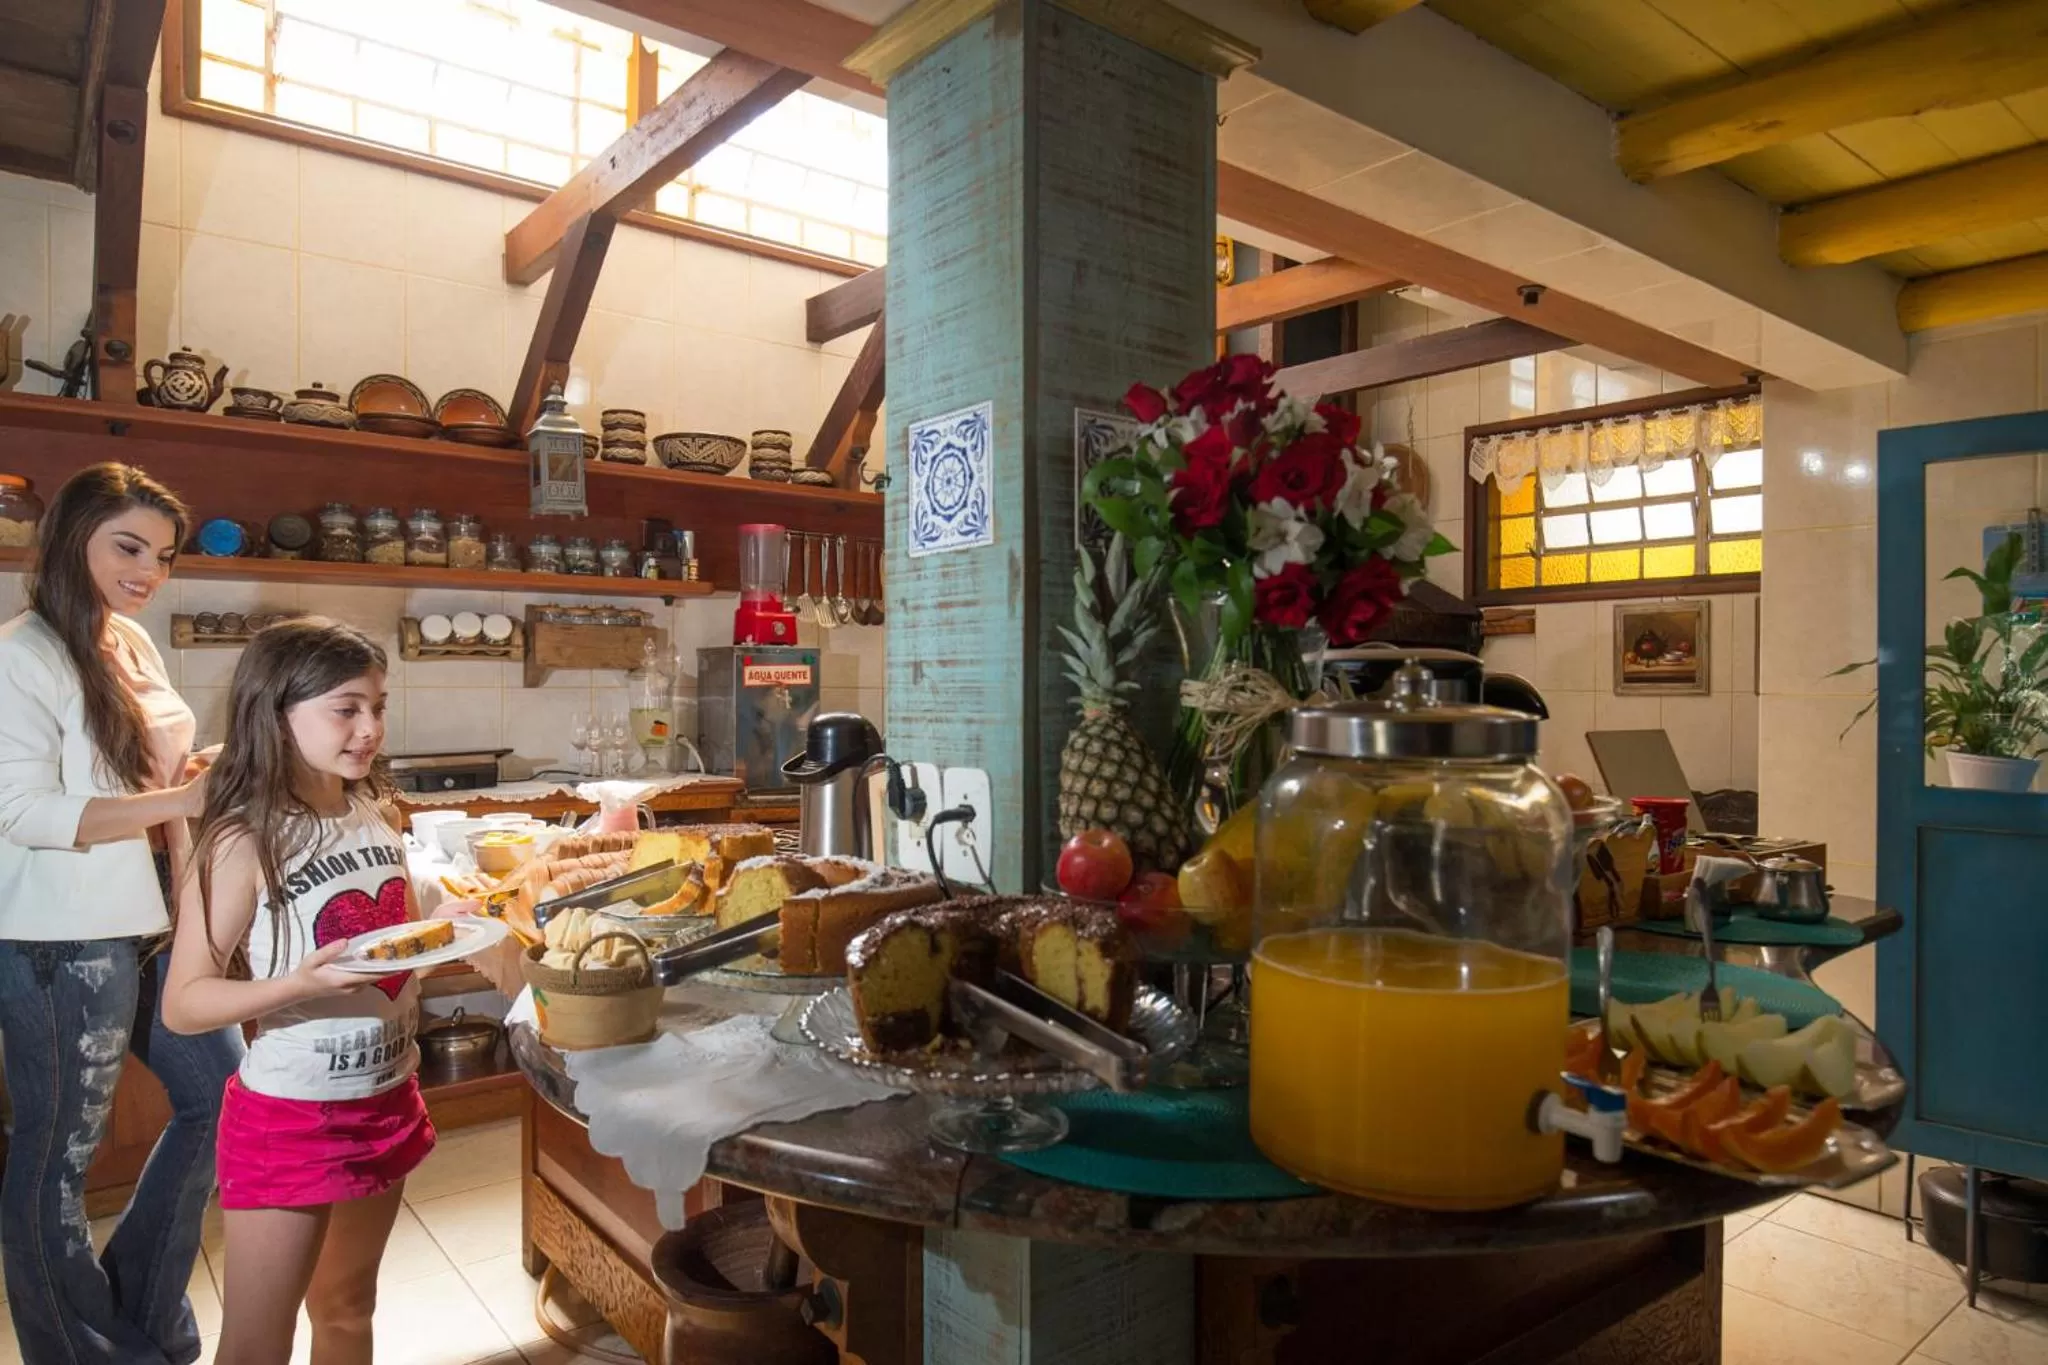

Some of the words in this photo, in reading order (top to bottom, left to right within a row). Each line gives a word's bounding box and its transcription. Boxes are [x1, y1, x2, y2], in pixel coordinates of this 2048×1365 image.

[774, 670, 808, 680] QUENTE
[263, 851, 360, 908] ASHION
[328, 1054, 350, 1071] IS
[355, 1052, 367, 1068] A
